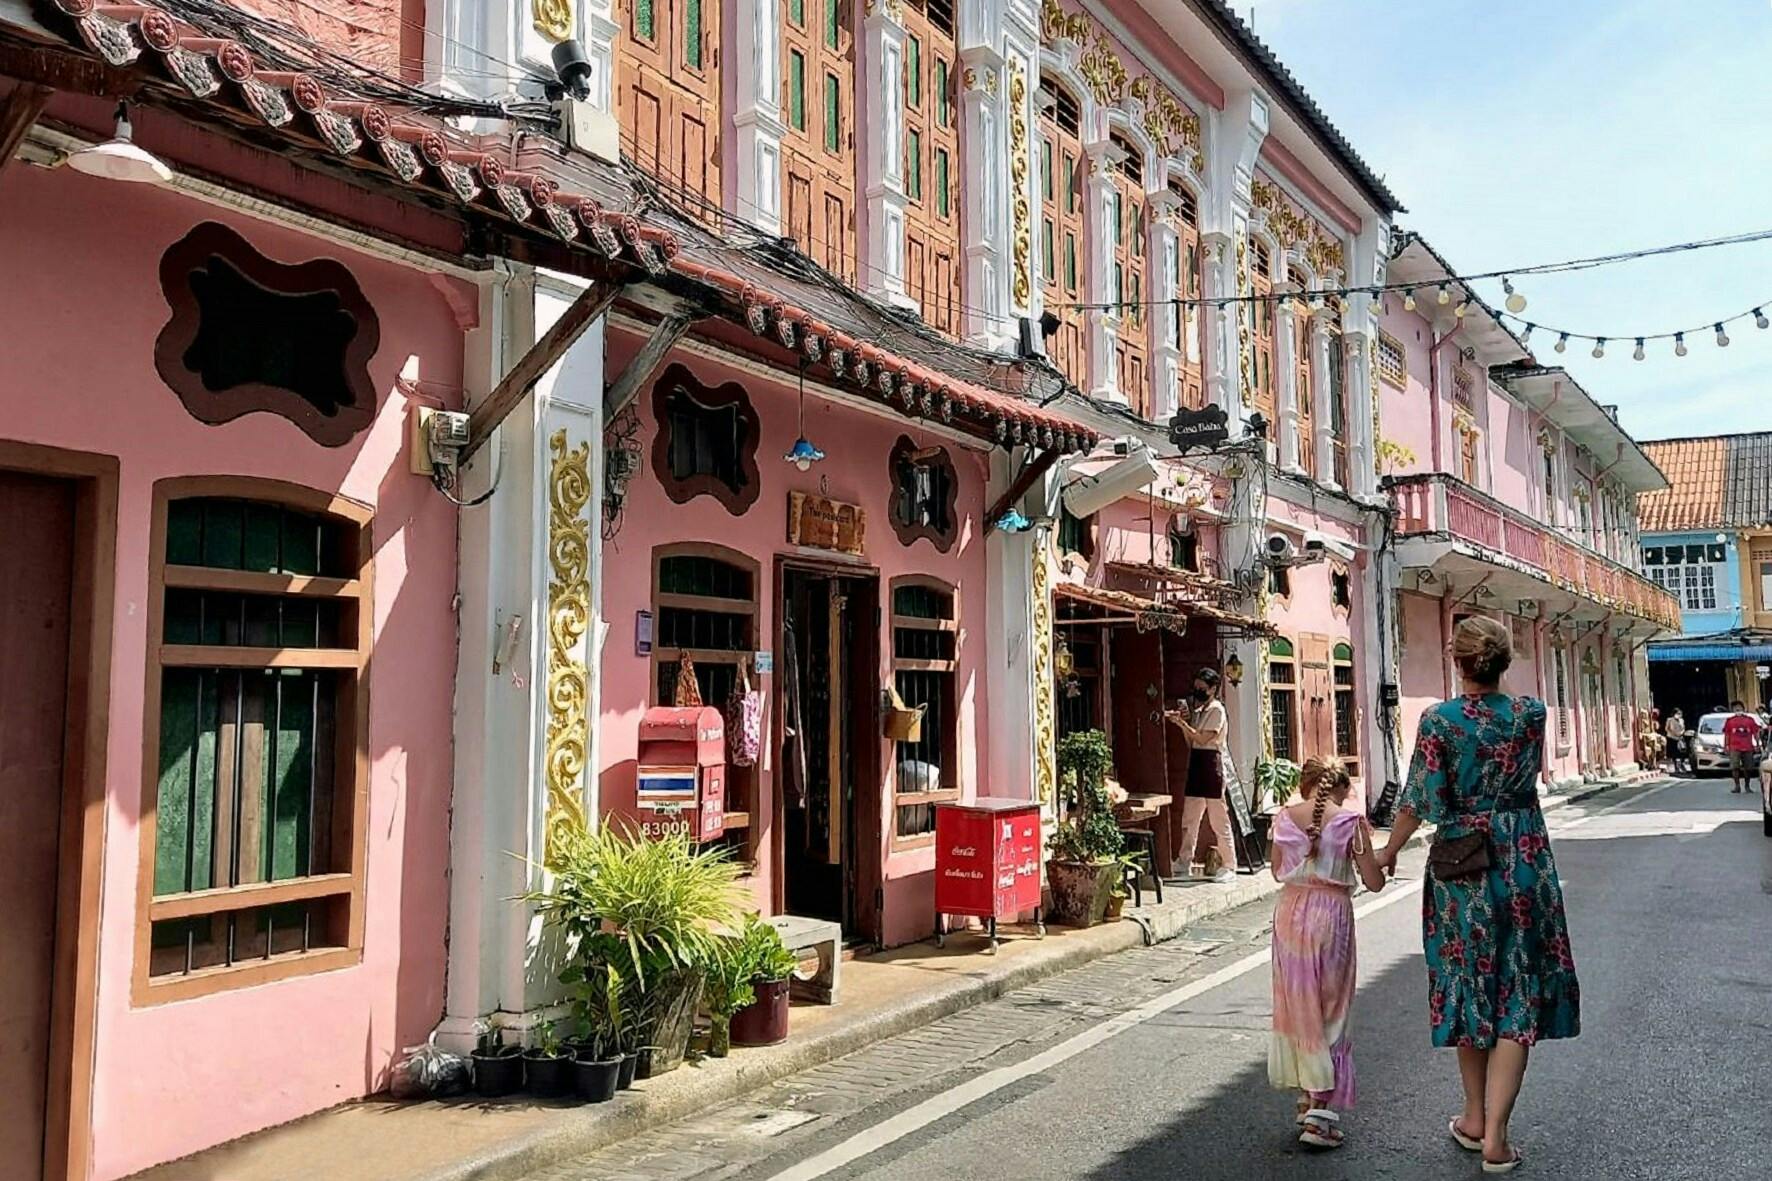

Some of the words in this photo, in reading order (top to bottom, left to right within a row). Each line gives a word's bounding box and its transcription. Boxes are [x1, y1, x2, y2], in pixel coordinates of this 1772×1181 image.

[1175, 424, 1198, 434] Casa
[1198, 421, 1222, 432] Baba
[642, 820, 689, 836] 83000
